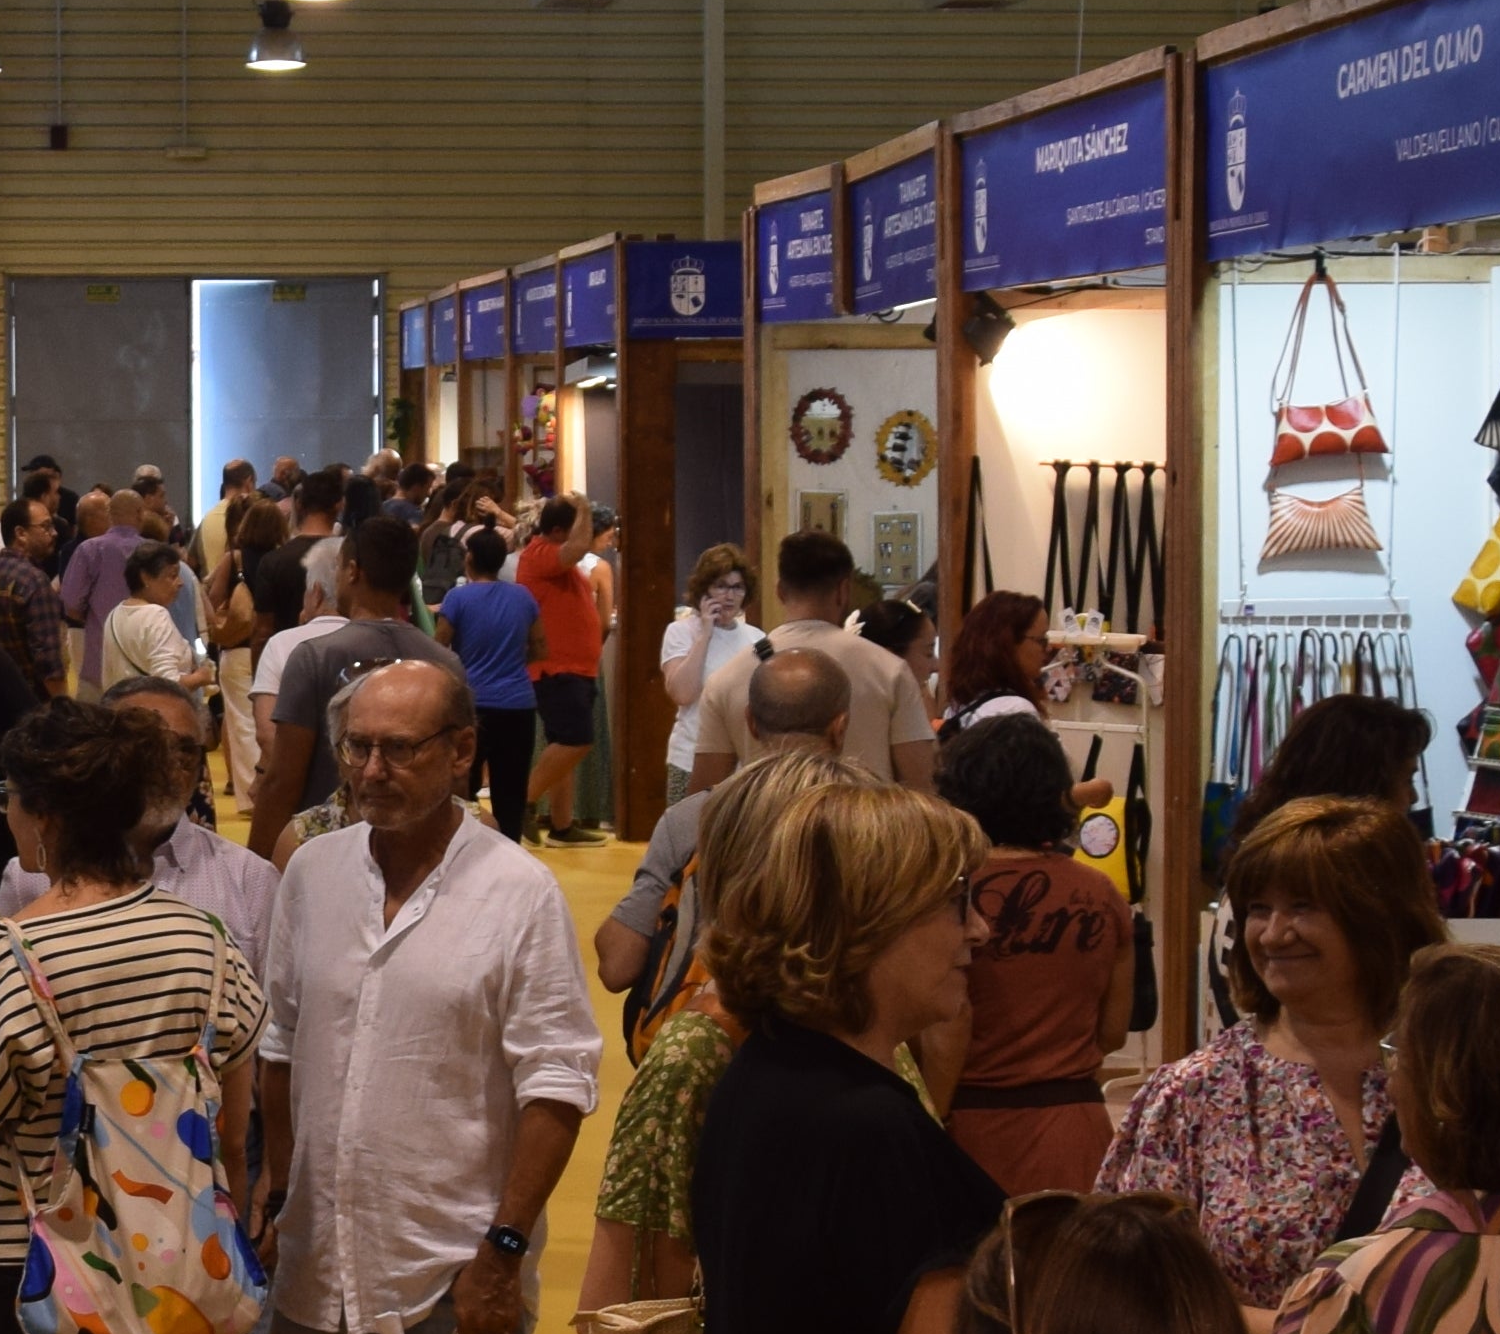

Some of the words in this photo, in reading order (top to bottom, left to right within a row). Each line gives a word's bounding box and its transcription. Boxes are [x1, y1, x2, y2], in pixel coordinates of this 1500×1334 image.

[1337, 48, 1398, 99] CARMEN
[1401, 40, 1430, 82] DEL
[1434, 24, 1484, 74] OLMO
[1035, 134, 1084, 174] MARIQUITA
[1084, 124, 1129, 162] SÁNCHEZ
